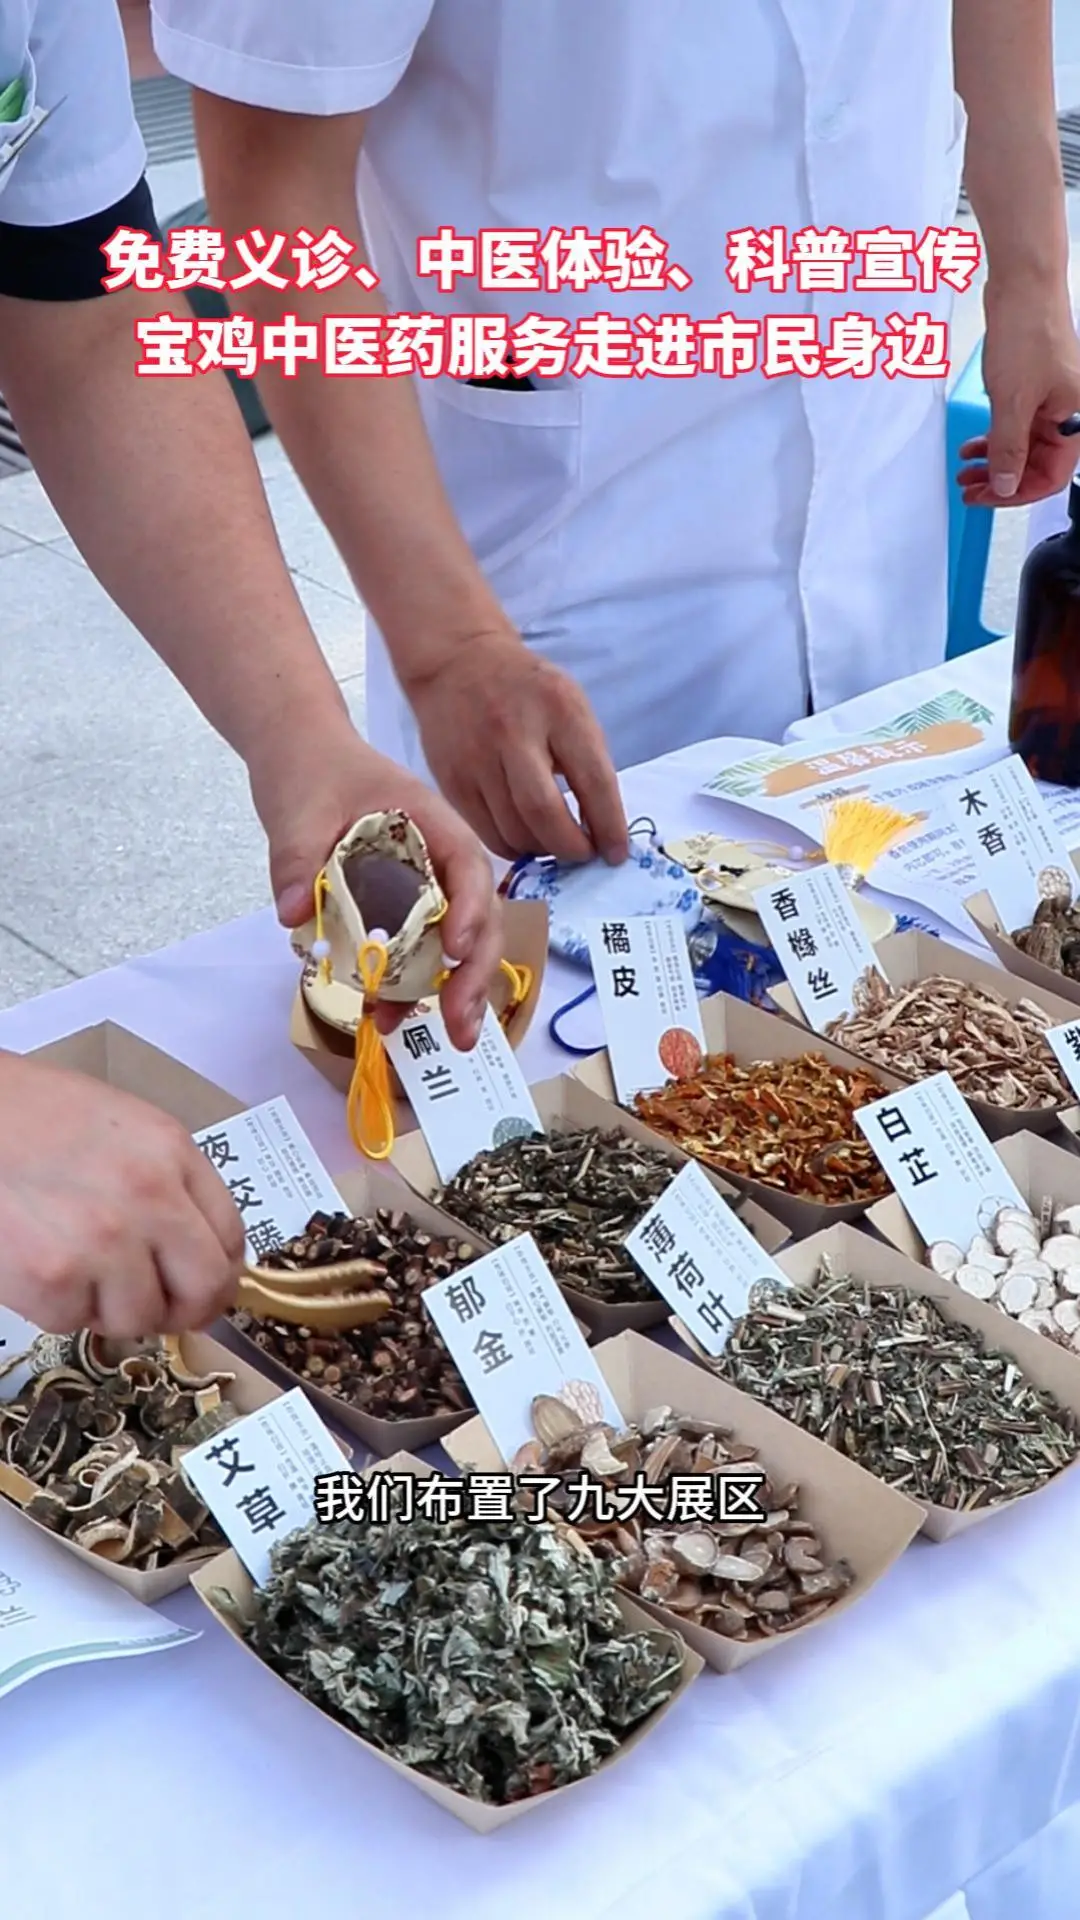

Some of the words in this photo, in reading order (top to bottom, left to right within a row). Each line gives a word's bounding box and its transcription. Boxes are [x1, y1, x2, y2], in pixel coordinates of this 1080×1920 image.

[959, 787, 1007, 857] 木香
[601, 921, 640, 998] 橘皮
[402, 1023, 461, 1102] 佩兰
[875, 1106, 939, 1187] 白芷
[638, 1213, 736, 1335] 薄荷叶
[443, 1274, 514, 1376] 郁金
[204, 1436, 288, 1535] 艾草
